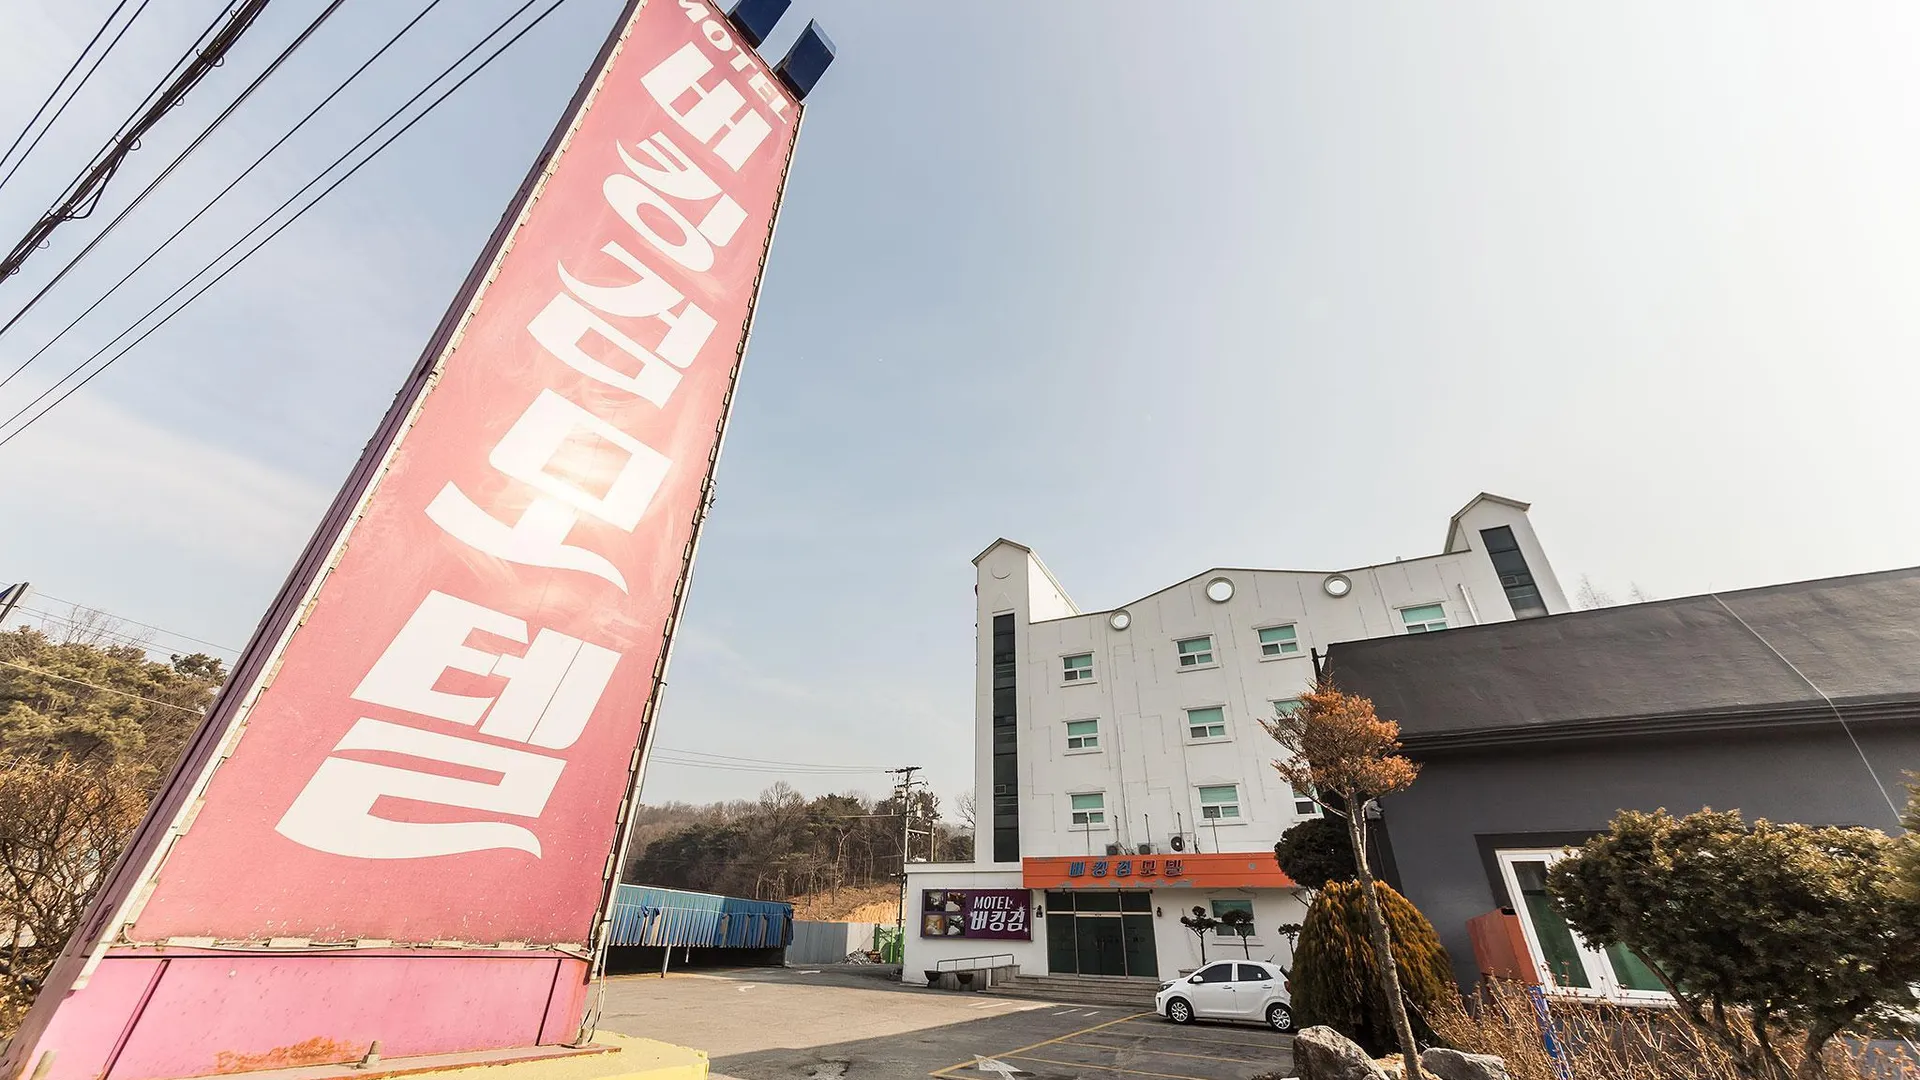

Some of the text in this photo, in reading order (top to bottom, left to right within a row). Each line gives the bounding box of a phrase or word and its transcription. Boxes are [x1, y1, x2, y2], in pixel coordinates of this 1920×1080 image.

[678, 0, 791, 124] MOTEL
[973, 896, 1011, 910] MOTEL
[970, 910, 1026, 932] 버킹검
